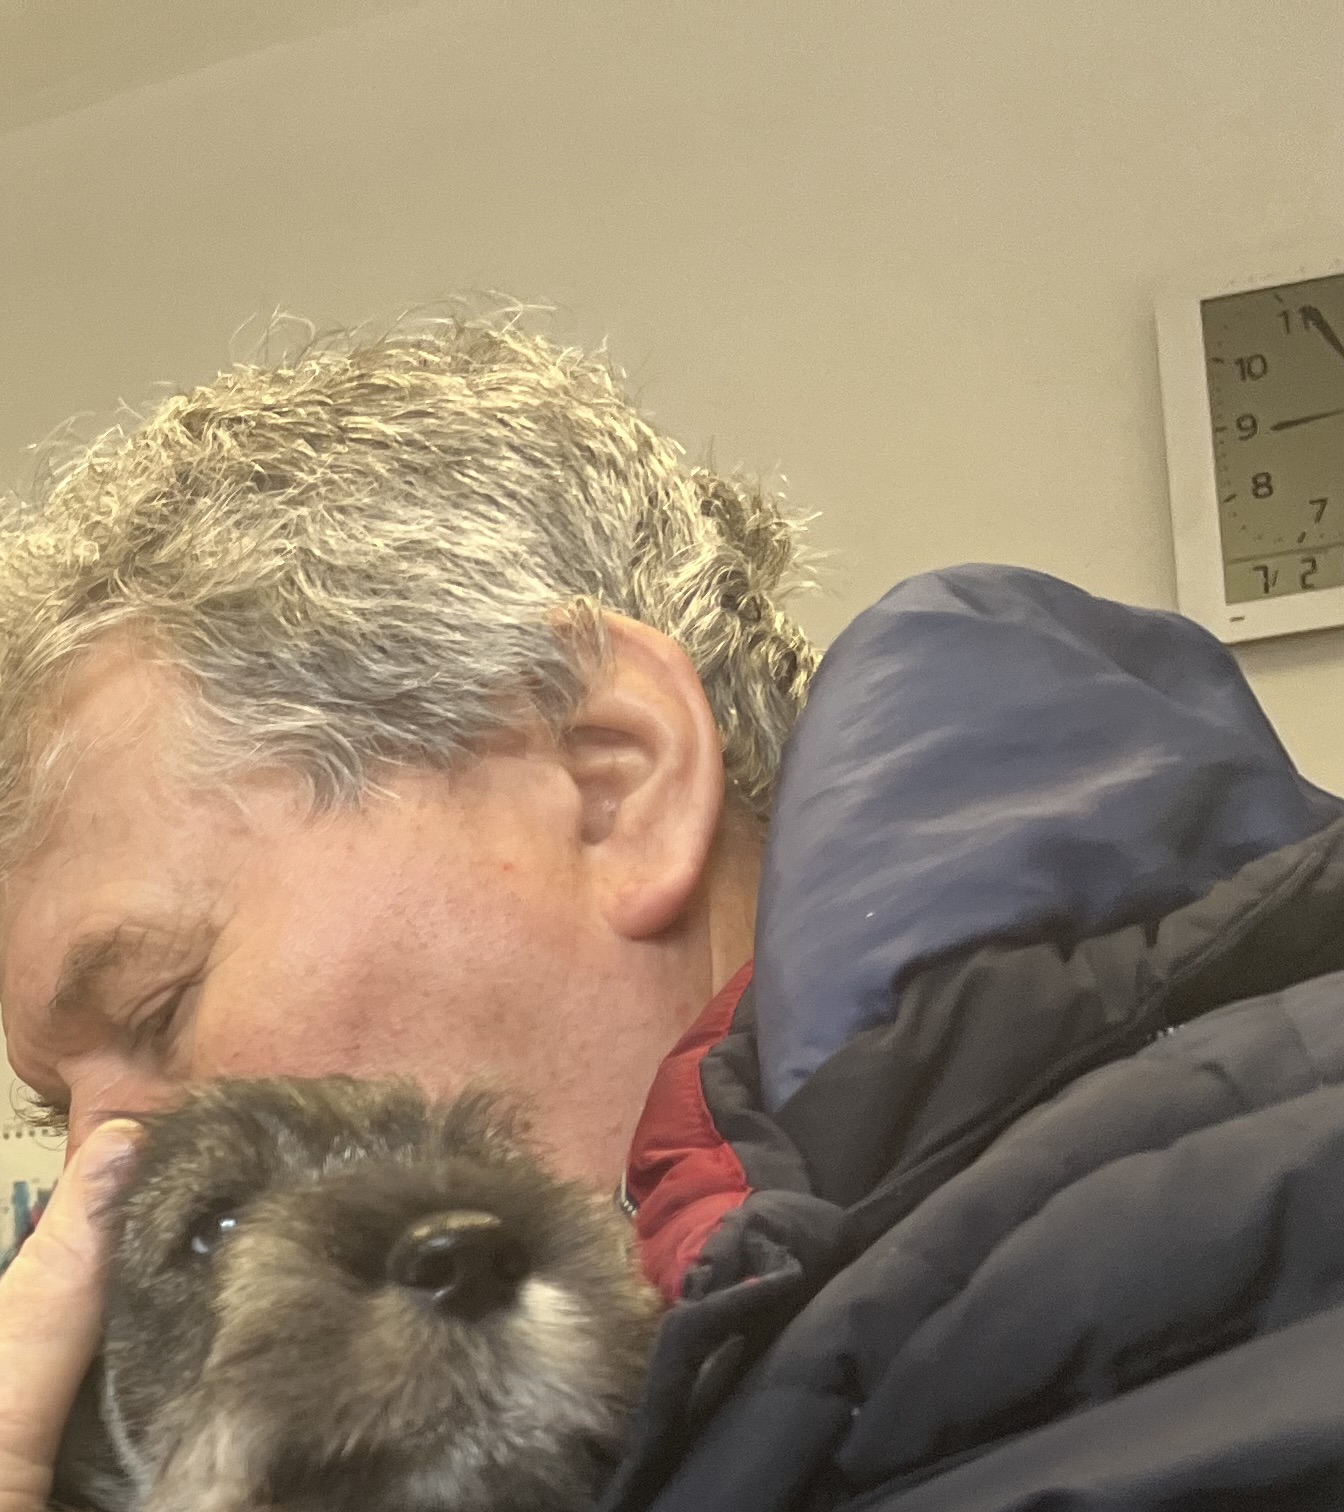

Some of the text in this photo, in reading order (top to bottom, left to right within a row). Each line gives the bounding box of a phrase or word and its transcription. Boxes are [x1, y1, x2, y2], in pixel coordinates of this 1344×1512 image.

[1235, 353, 1268, 382] 10
[1235, 413, 1258, 441] 9
[1251, 471, 1274, 499] 8
[1308, 497, 1329, 525] 7
